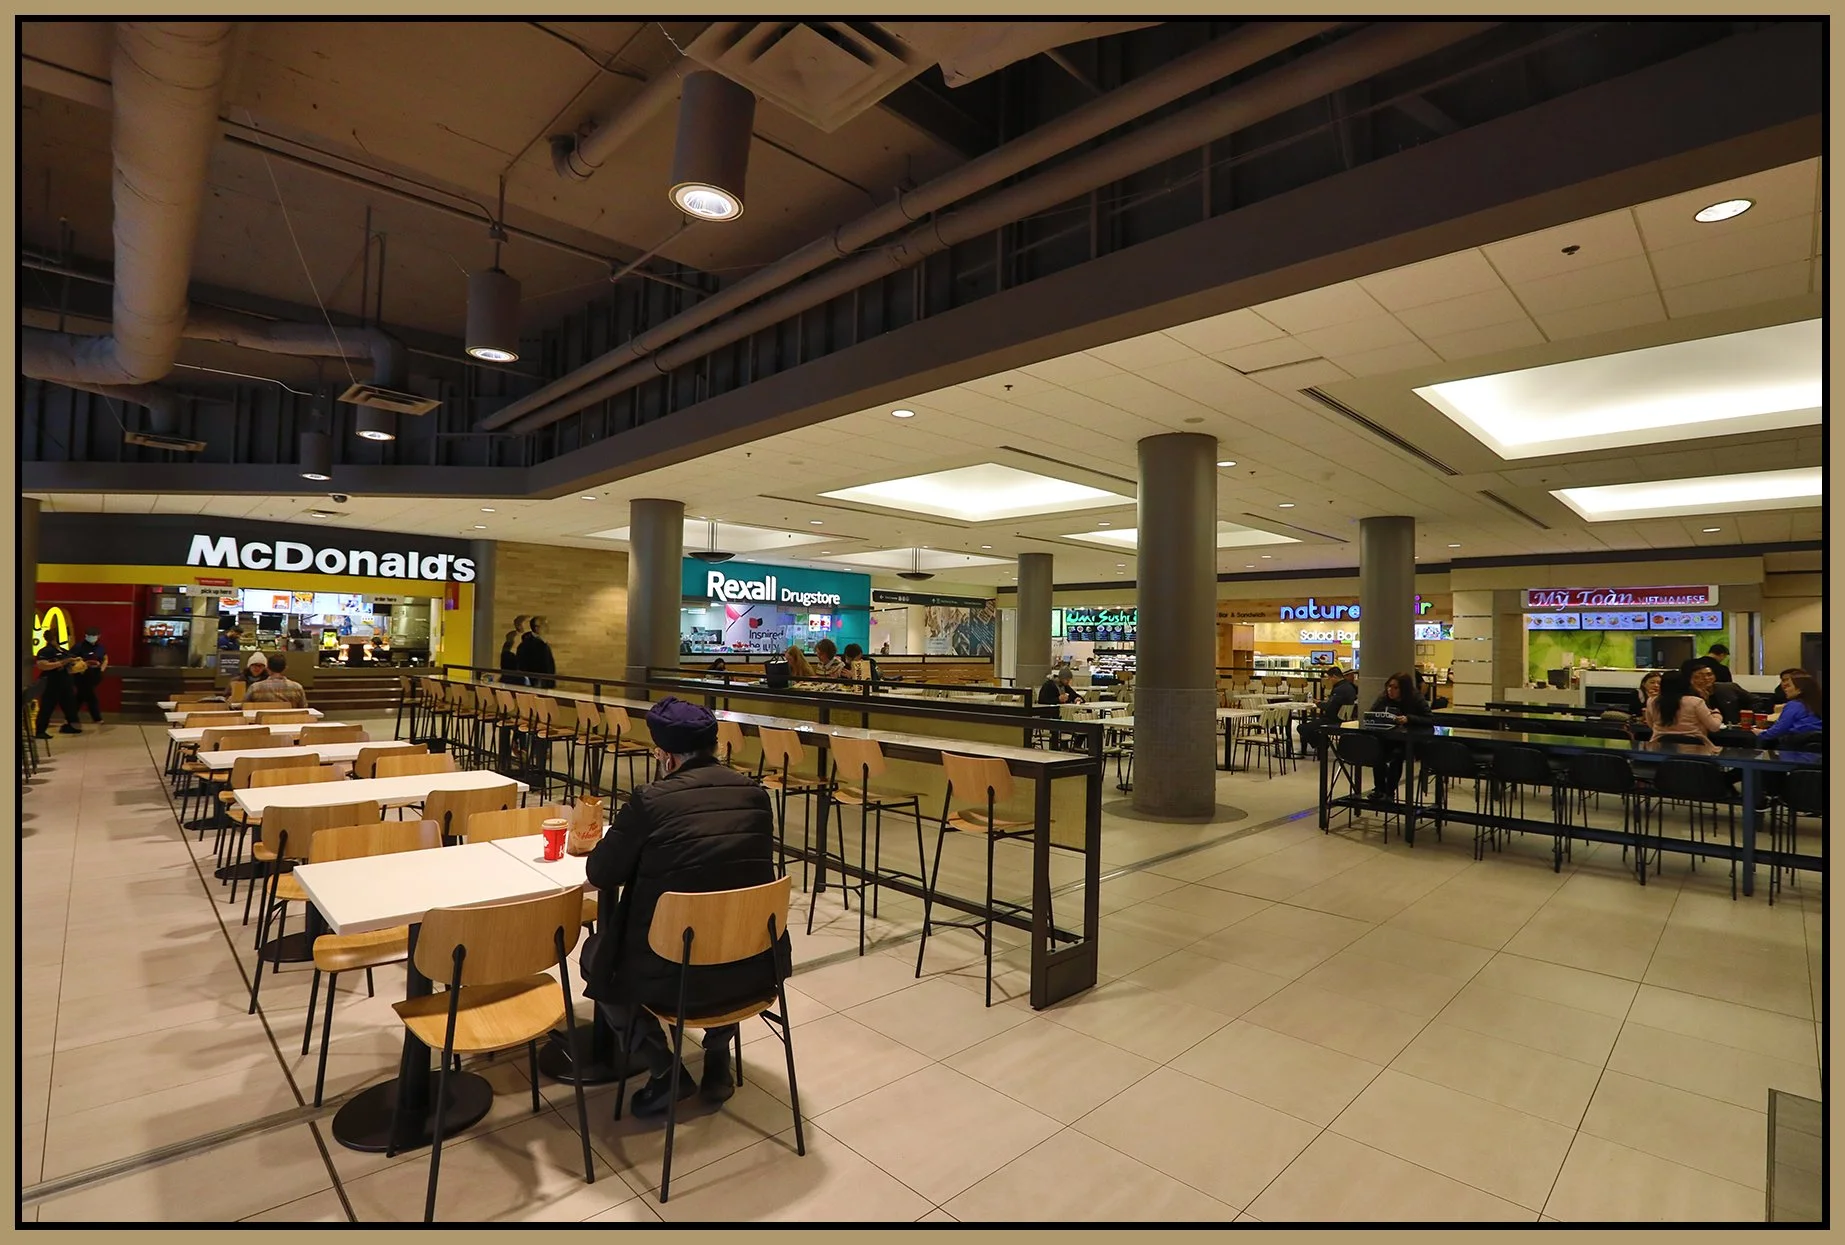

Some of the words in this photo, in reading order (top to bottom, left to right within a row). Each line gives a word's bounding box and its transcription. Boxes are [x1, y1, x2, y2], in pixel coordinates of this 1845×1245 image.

[186, 534, 476, 582] McDonald's
[707, 570, 777, 602] Rexall
[781, 587, 841, 607] Drugstore
[1576, 589, 1635, 606] Toàn
[1637, 594, 1706, 605] VIETNAMESE
[1066, 610, 1096, 623] Umi
[1098, 609, 1132, 626] Sushi
[1299, 629, 1335, 641] Salad
[1337, 629, 1359, 641] Bar
